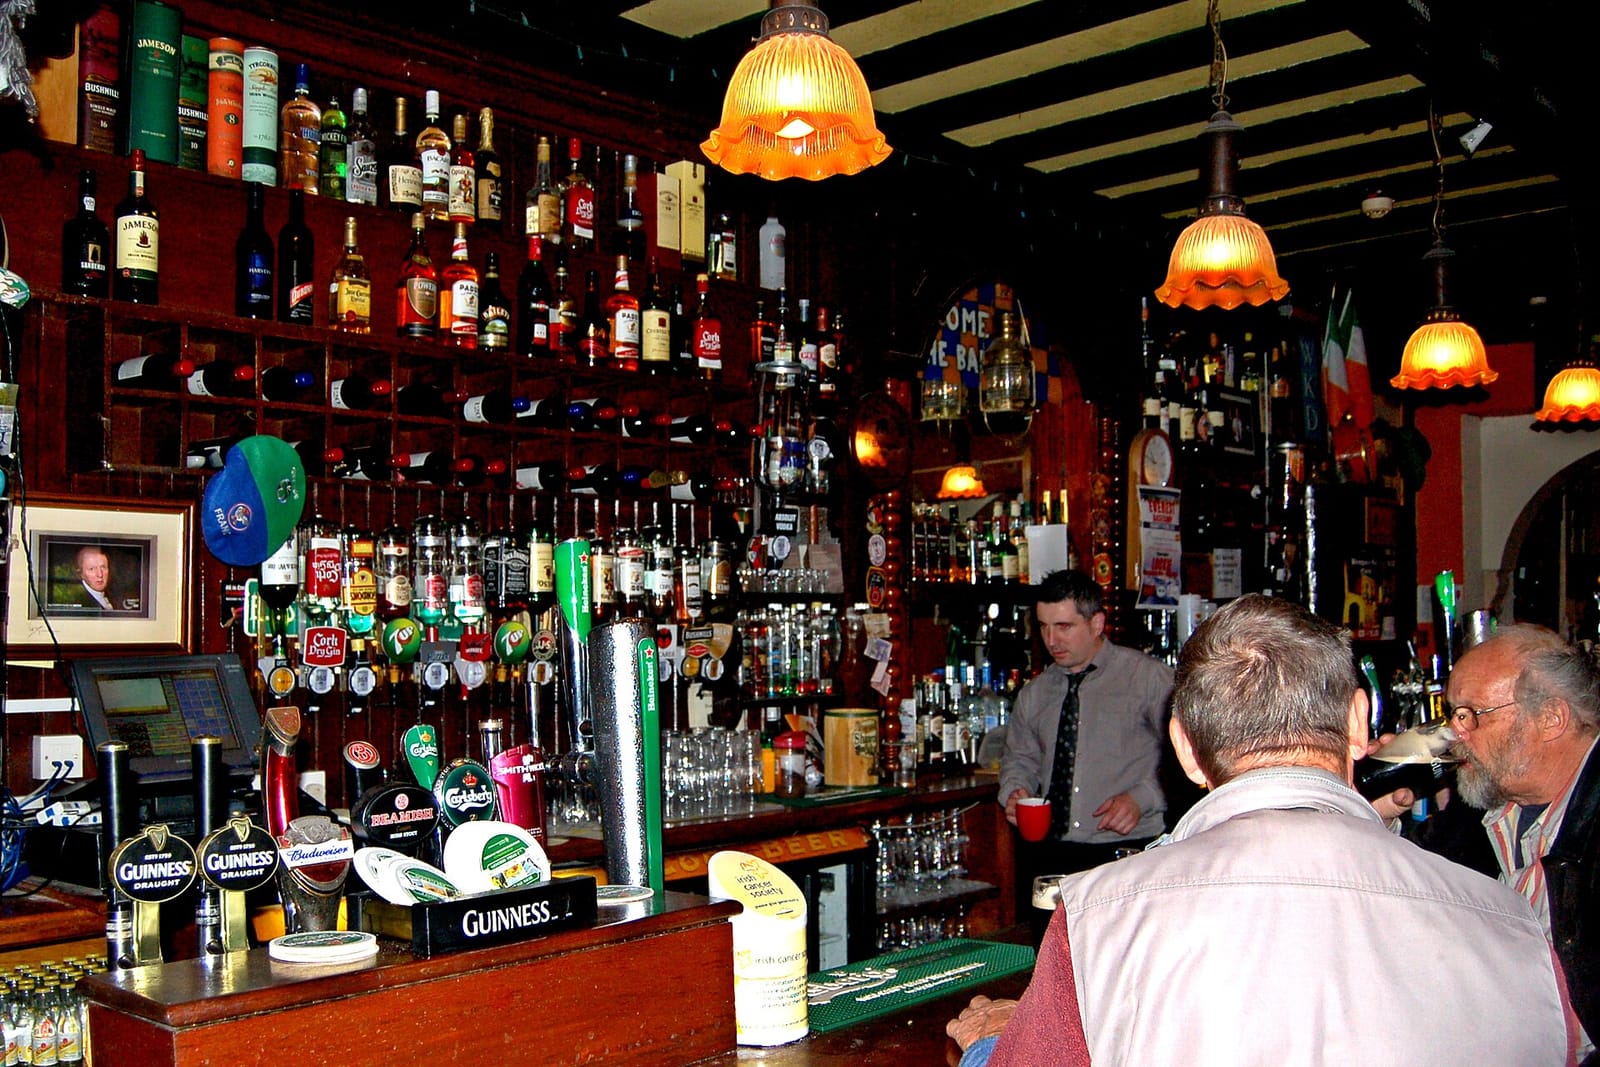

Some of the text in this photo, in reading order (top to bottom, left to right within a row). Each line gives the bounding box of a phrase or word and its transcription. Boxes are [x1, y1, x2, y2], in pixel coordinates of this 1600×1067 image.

[137, 39, 177, 56] JAMESON
[100, 120, 108, 128] 16
[122, 219, 159, 232] JAMESO
[482, 305, 510, 320] BAILEYS
[581, 565, 589, 613] Heineken
[313, 632, 338, 647] Cork
[308, 645, 341, 658] Dry Gin
[647, 661, 656, 711] Heineken
[446, 785, 493, 809] Carlsberg
[371, 808, 434, 827] BEAMISH
[765, 830, 848, 858] BEER
[207, 850, 275, 871] GUINNESS
[287, 846, 349, 861] Budweiser
[120, 860, 192, 881] GUINNESS
[220, 868, 265, 880] DRAUGHT
[133, 878, 181, 890] DRAUGHT
[737, 874, 757, 884] irish
[750, 888, 784, 899] society
[462, 901, 550, 937] GUINNESS
